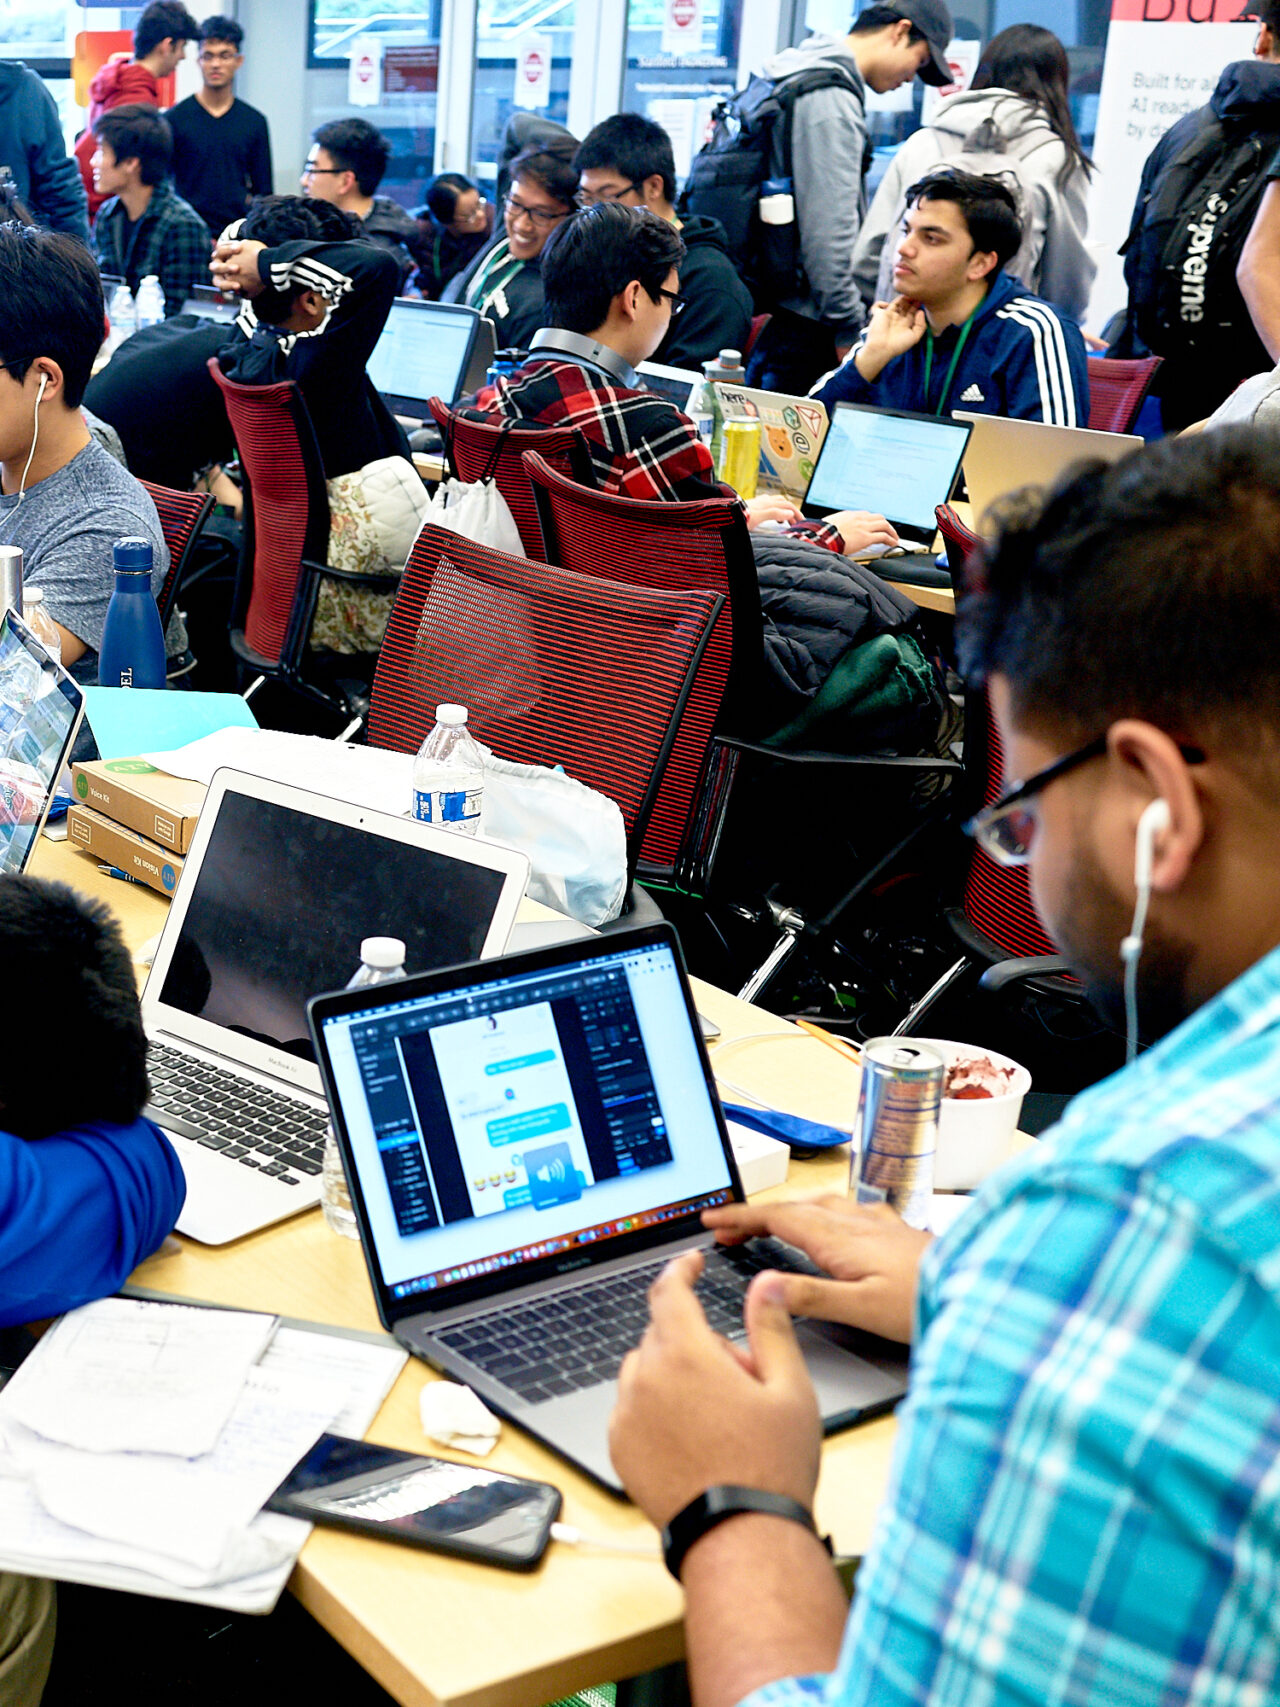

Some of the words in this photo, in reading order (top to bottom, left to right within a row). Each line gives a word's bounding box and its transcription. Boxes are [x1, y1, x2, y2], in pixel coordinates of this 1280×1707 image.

[1133, 71, 1169, 89] Built
[1174, 72, 1197, 91] for
[1130, 97, 1148, 113] AI
[1127, 122, 1146, 140] by
[120, 667, 133, 688] EL
[90, 786, 103, 801] Voice
[142, 859, 160, 877] Vision
